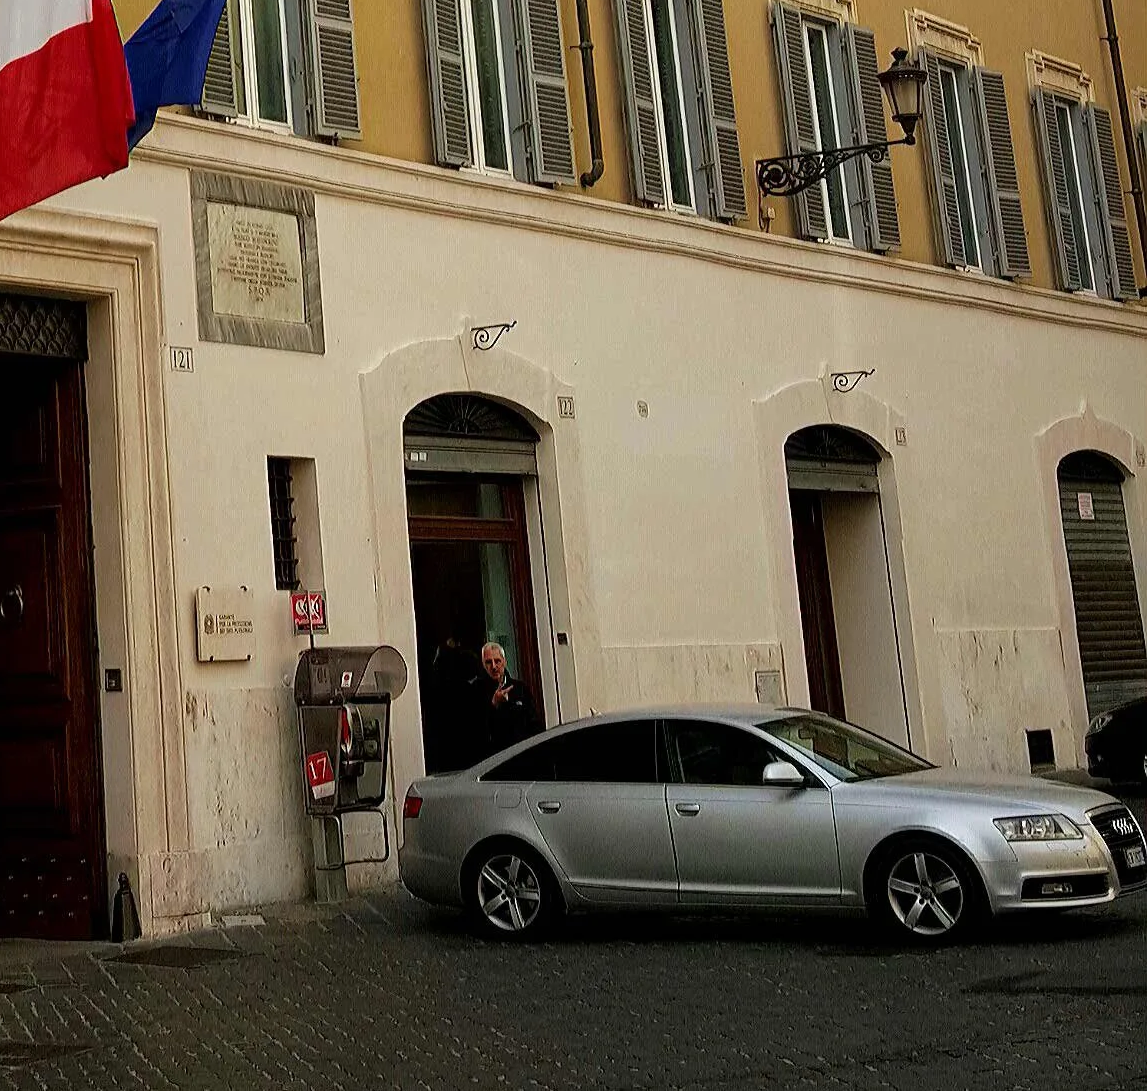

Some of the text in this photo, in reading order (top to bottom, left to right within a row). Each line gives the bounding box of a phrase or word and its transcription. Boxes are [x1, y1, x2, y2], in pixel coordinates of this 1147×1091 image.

[173, 349, 191, 370] 121
[559, 399, 574, 416] 122
[308, 756, 327, 780] 17
